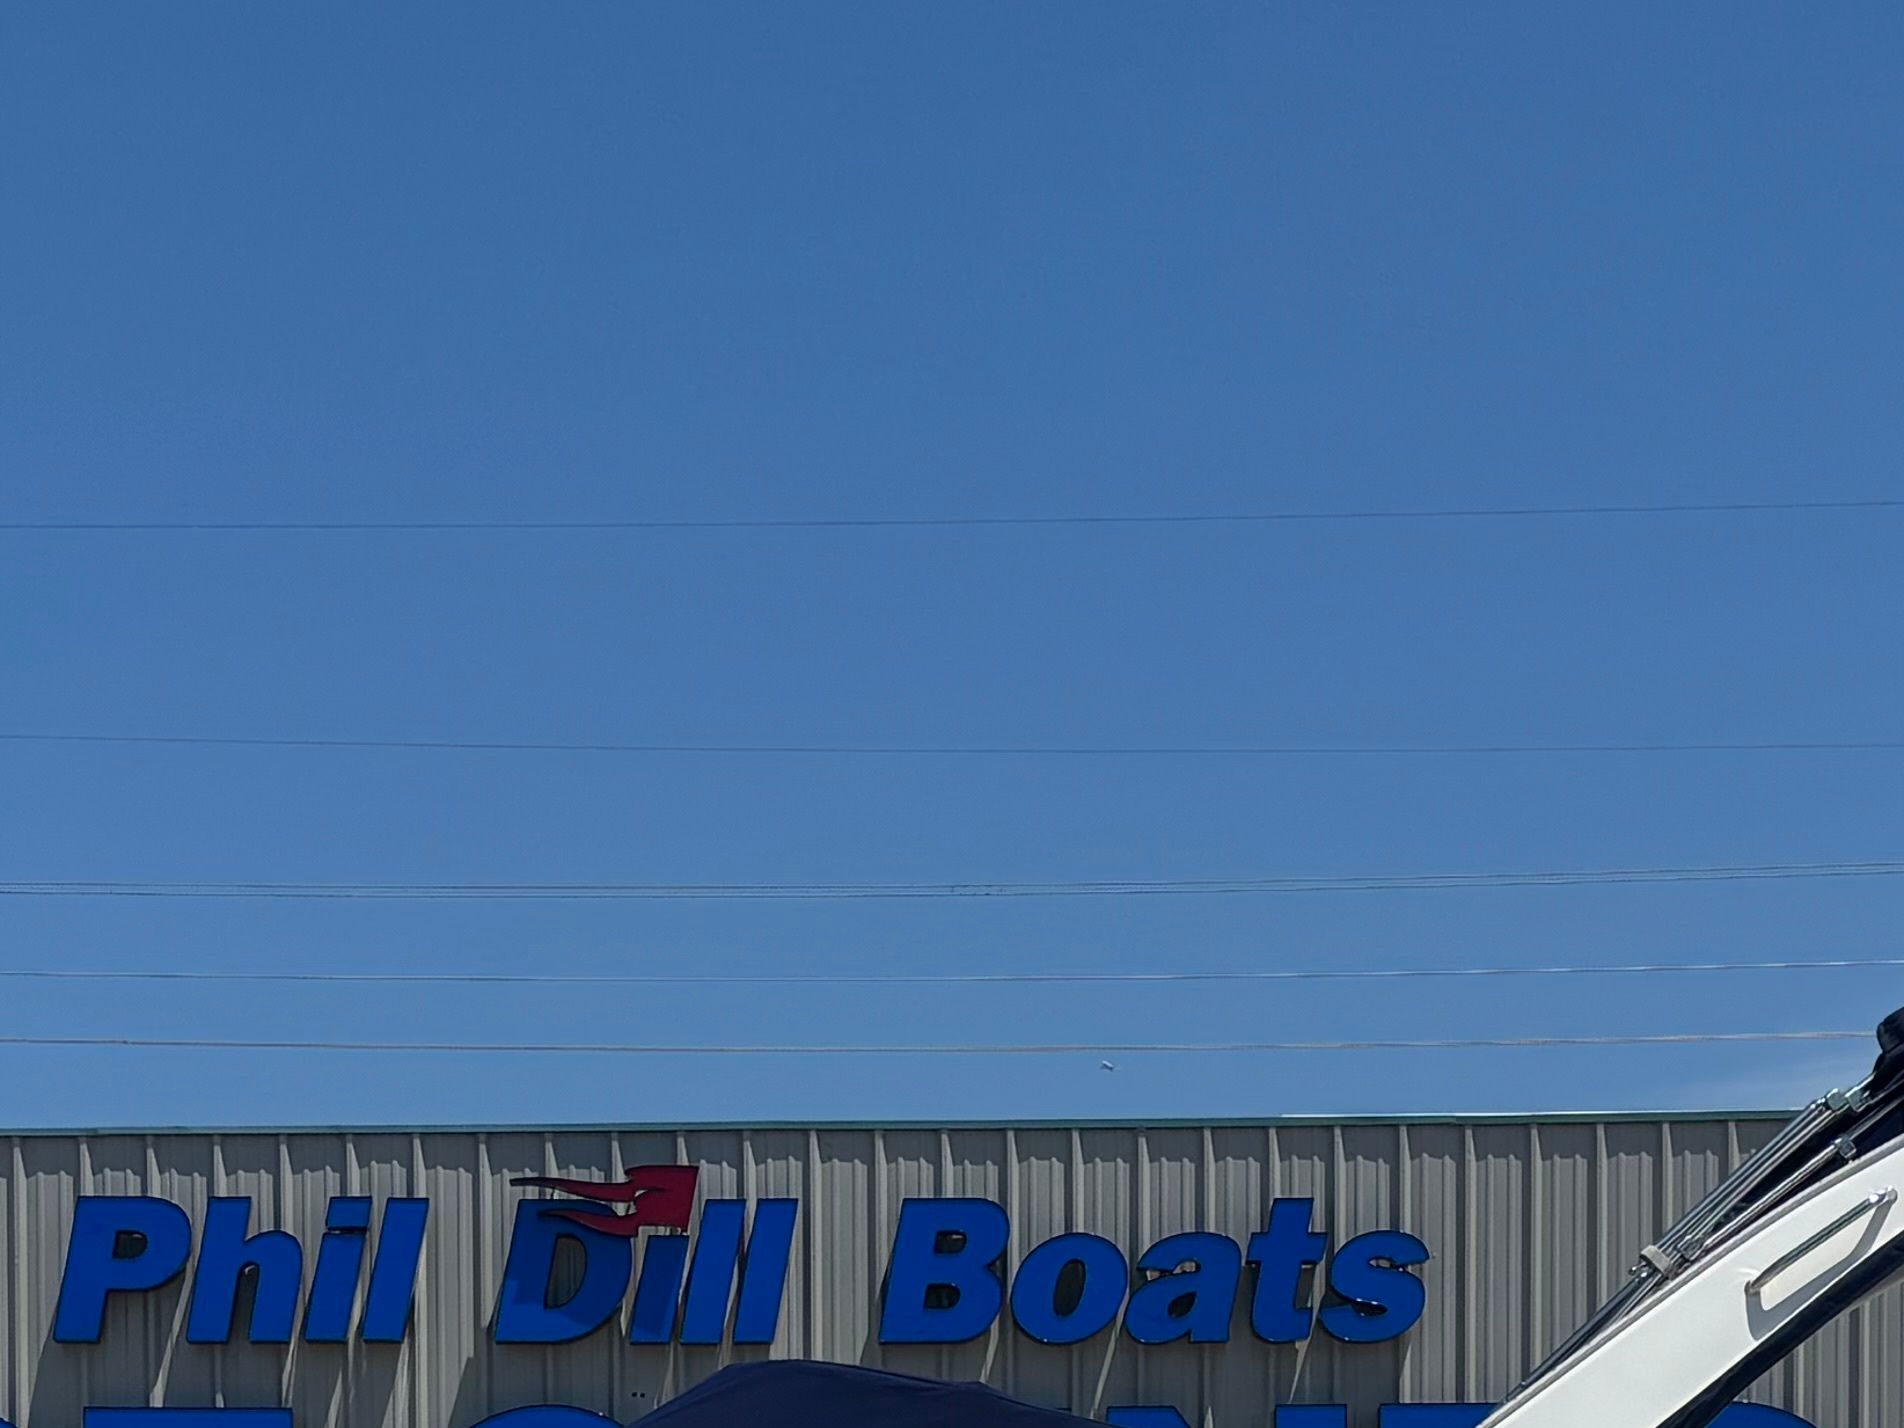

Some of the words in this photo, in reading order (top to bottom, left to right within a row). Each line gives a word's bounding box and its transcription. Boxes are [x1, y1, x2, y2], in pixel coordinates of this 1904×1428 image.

[53, 1196, 428, 1345] Phil
[497, 1196, 798, 1346] Dill
[879, 1196, 1432, 1346] Boats
